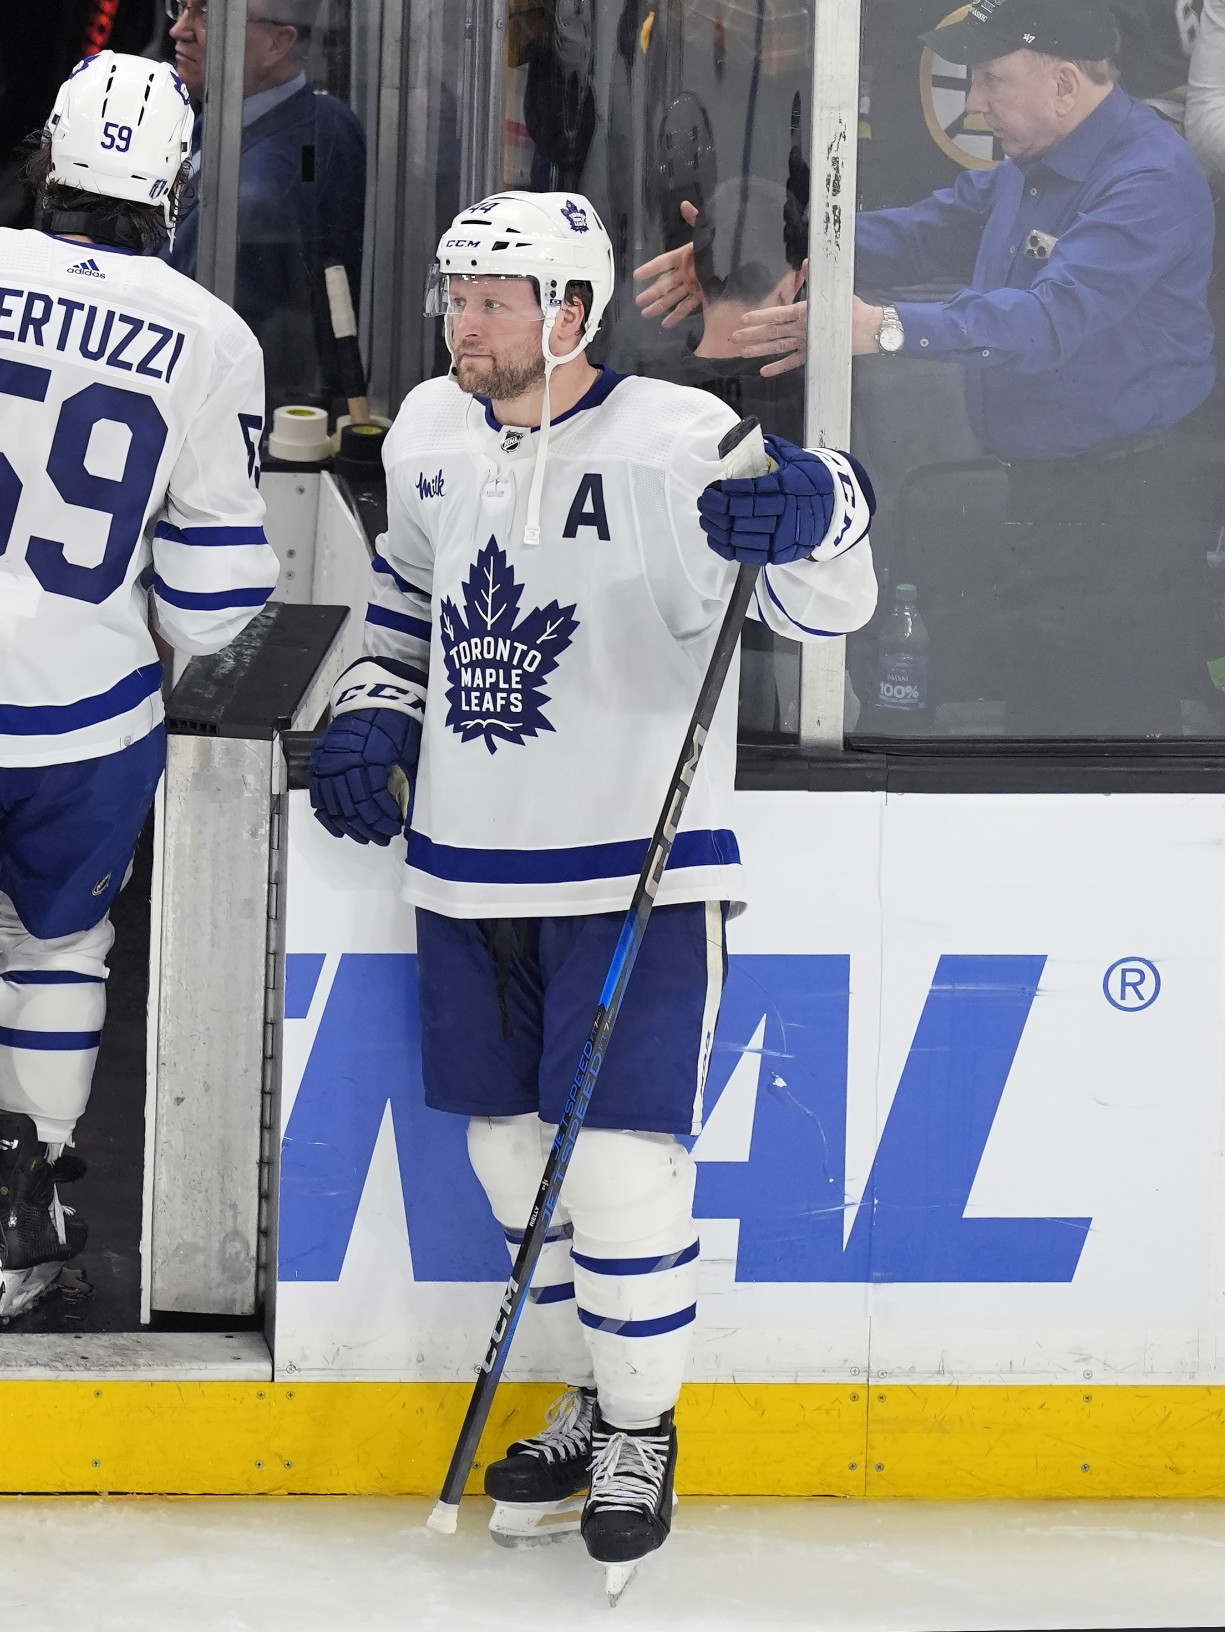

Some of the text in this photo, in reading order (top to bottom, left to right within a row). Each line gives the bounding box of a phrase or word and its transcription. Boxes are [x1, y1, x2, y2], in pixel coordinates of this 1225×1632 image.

[100, 121, 133, 153] 59
[445, 239, 481, 248] CCM
[66, 267, 106, 280] adidas
[415, 468, 447, 502] Milk
[562, 473, 612, 541] A
[449, 635, 543, 673] TORONTO
[460, 669, 523, 691] MAPLE
[879, 681, 919, 699] 100%
[460, 691, 524, 713] LEAFS
[553, 1040, 595, 1160] JETSPEED
[541, 1052, 603, 1232] JETSPEED
[529, 1206, 540, 1228] RIELLY
[481, 1275, 520, 1375] CCM
